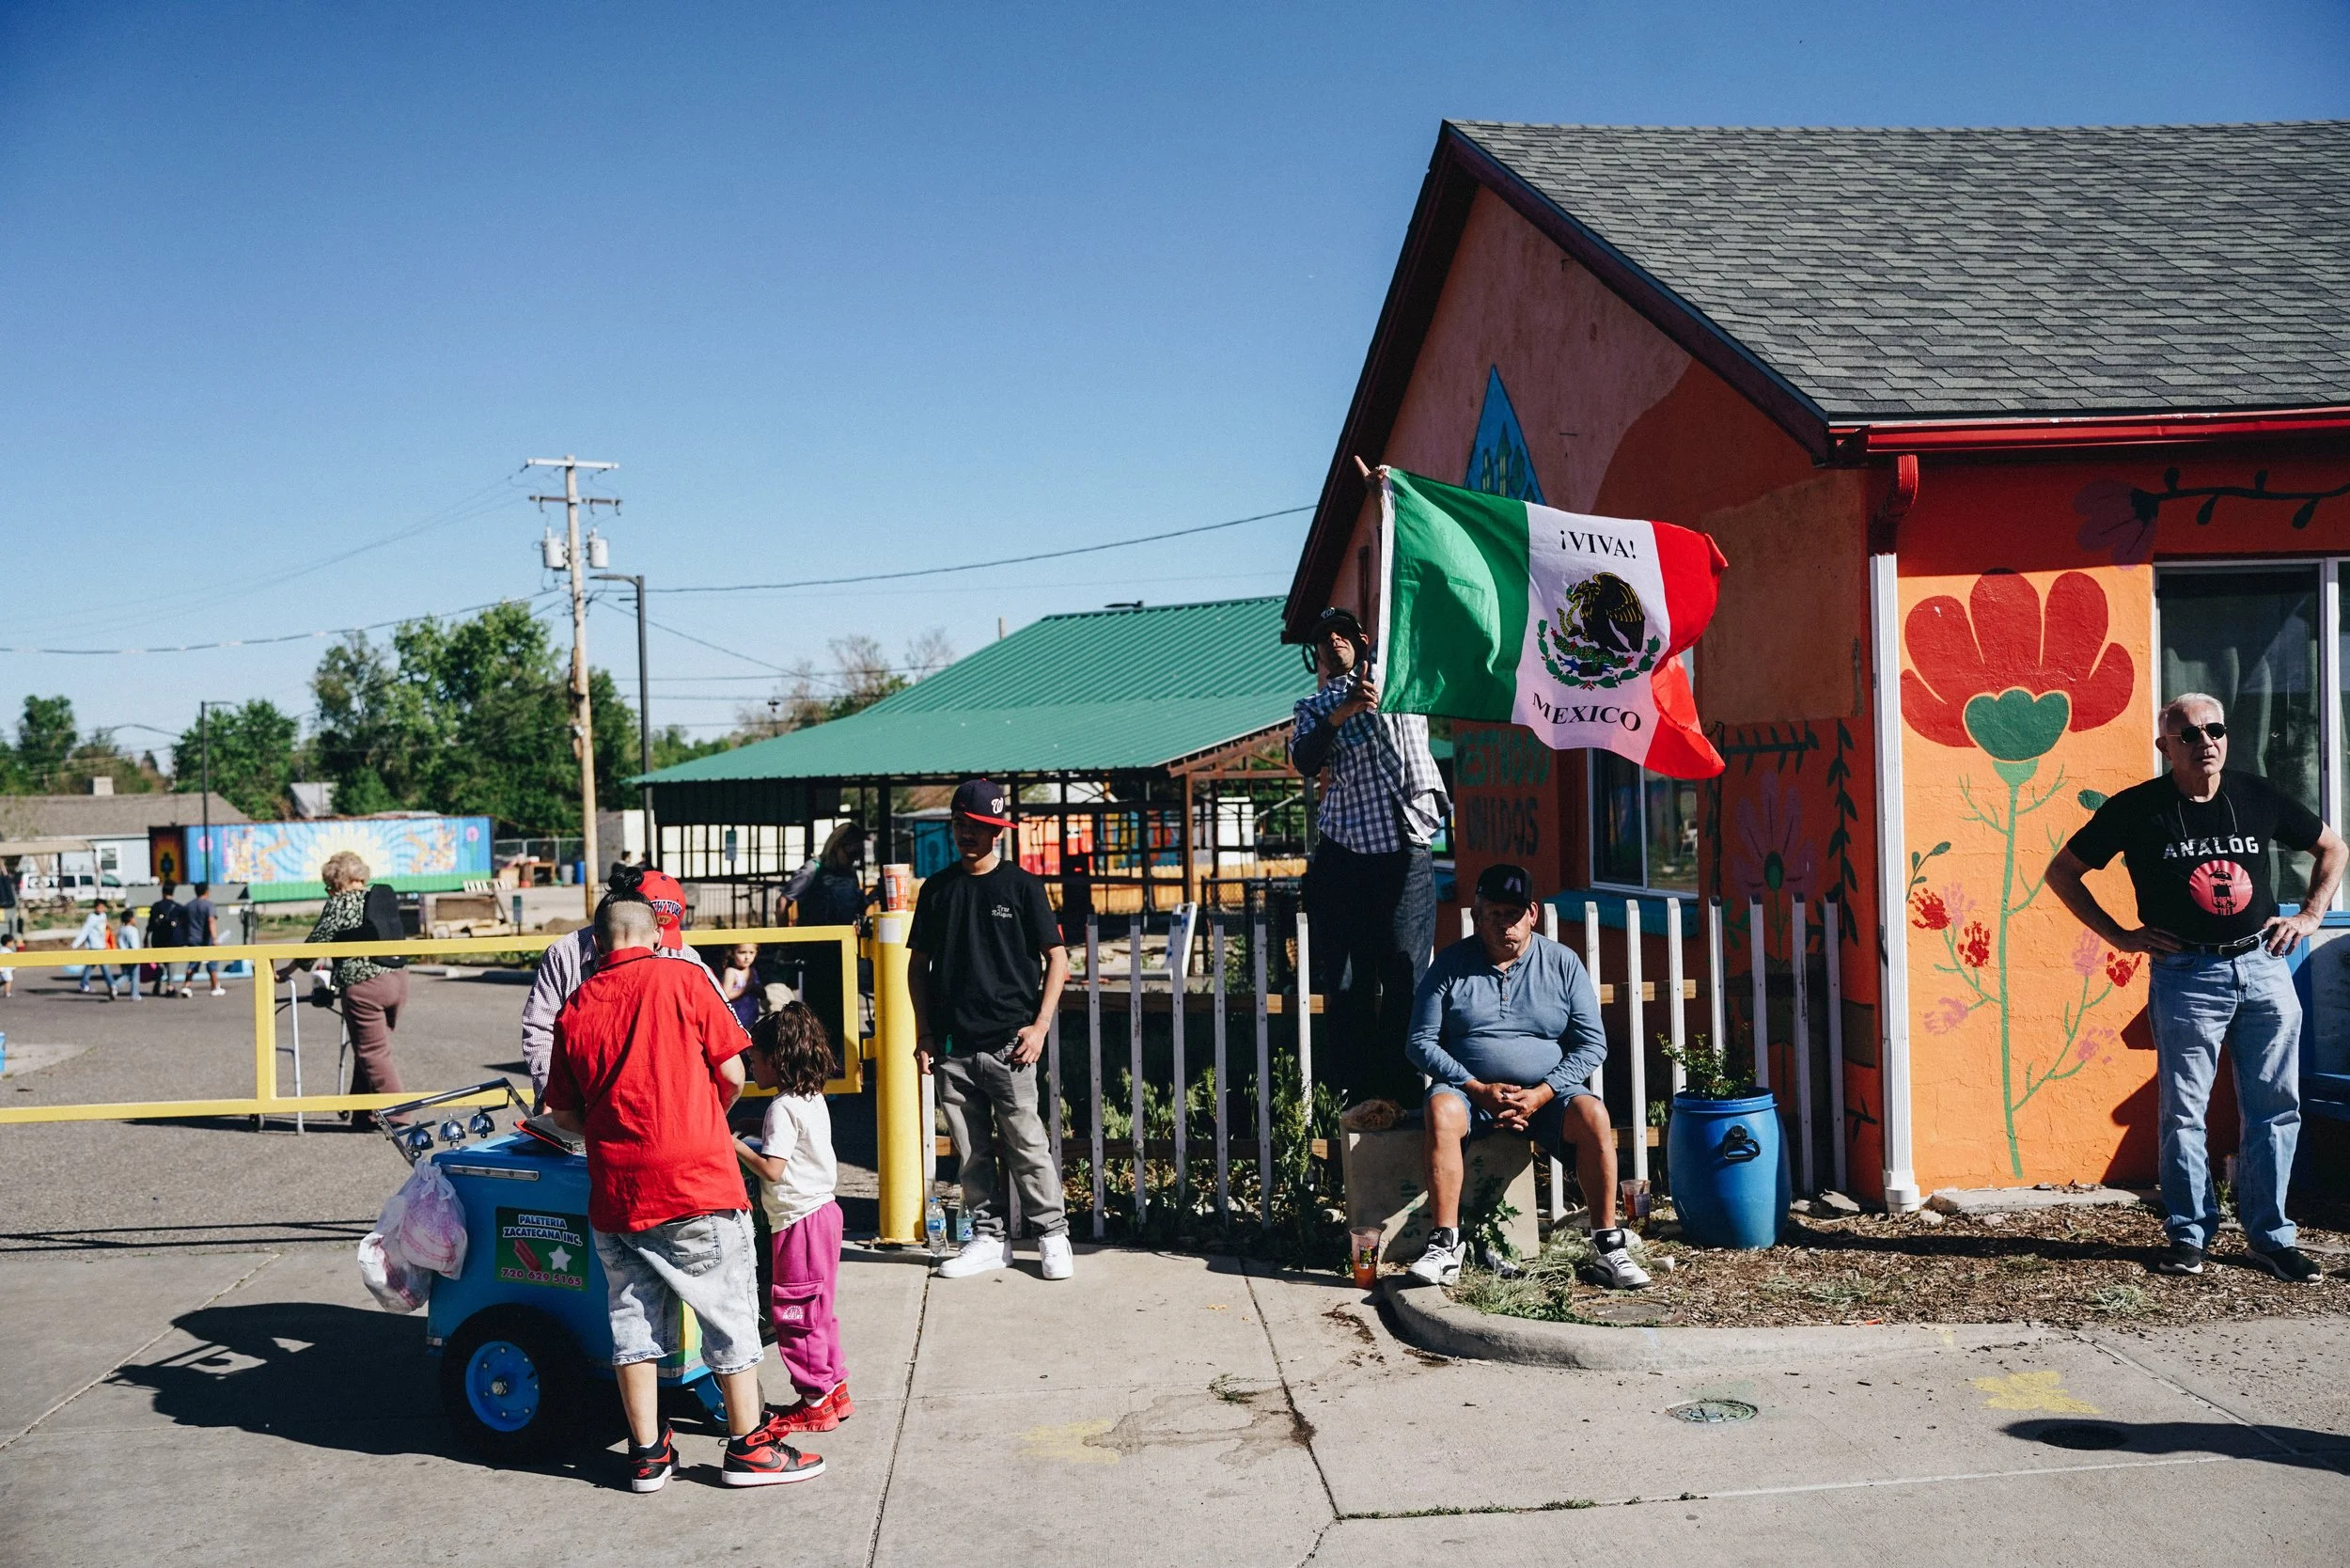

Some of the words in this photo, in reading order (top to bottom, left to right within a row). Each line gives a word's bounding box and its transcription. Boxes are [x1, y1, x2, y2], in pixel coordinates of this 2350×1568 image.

[1559, 529, 1637, 559] ¡VIVA!
[1532, 692, 1642, 732] MEXICO
[1464, 796, 1540, 858] UNIDOS
[2162, 836, 2260, 859] ANALOG
[518, 1215, 568, 1230] PALETERIA
[503, 1227, 562, 1242] ZACATECANA
[562, 1231, 583, 1247] INC.
[501, 1268, 525, 1279] 720
[528, 1271, 550, 1282] 629
[553, 1273, 583, 1287] 5165
